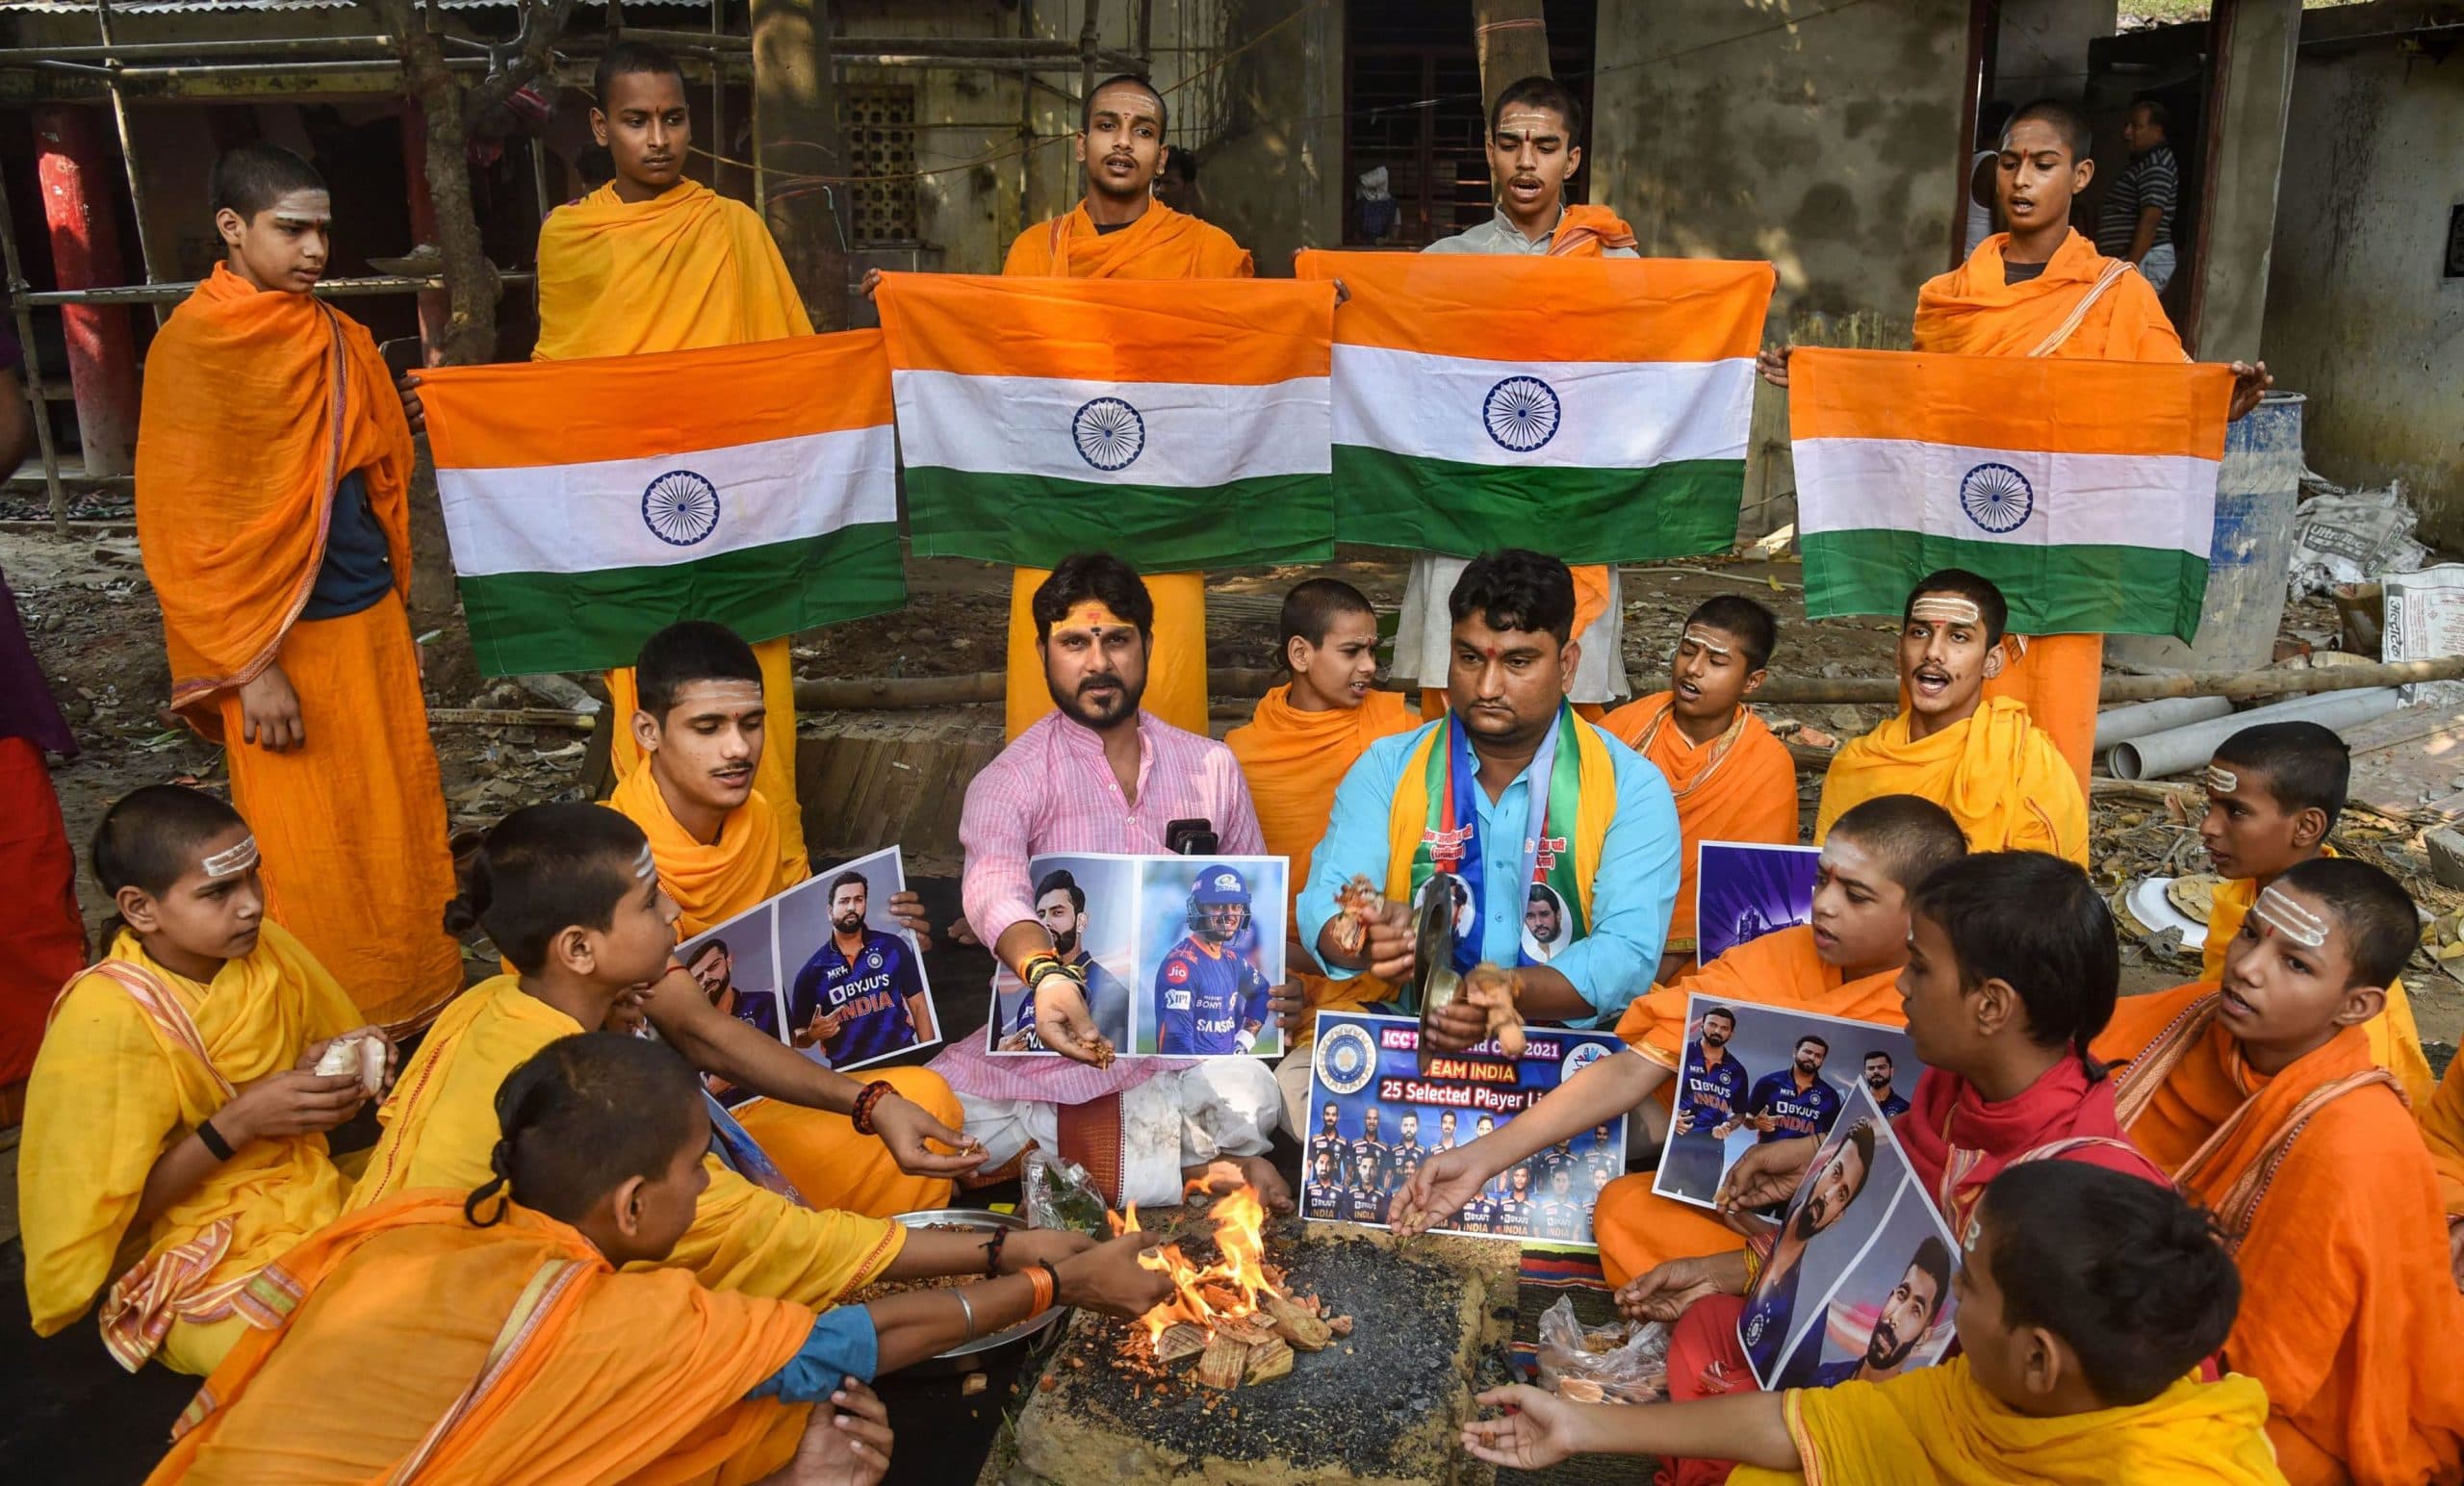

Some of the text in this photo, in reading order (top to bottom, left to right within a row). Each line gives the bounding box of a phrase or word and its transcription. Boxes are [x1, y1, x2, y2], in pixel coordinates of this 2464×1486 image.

[1168, 965, 1187, 977] Jio
[846, 973, 889, 996] BYJU'S
[836, 990, 895, 1022] INDIA
[1382, 1029, 1409, 1048] ICC
[1526, 1041, 1559, 1058] 2021
[1430, 1059, 1516, 1082] EAM INDIA
[1382, 1081, 1402, 1099] 25
[1405, 1082, 1471, 1104] Selected
[1475, 1089, 1522, 1113] Player
[1702, 1082, 1732, 1098] BYJU'S
[1694, 1092, 1730, 1113] INDIA
[1788, 1104, 1820, 1119] BYJU'S
[1774, 1115, 1815, 1134] INDIA
[1354, 1210, 1375, 1220] INDIA
[1463, 1223, 1489, 1233] INDIA
[1503, 1224, 1528, 1236] INDIA
